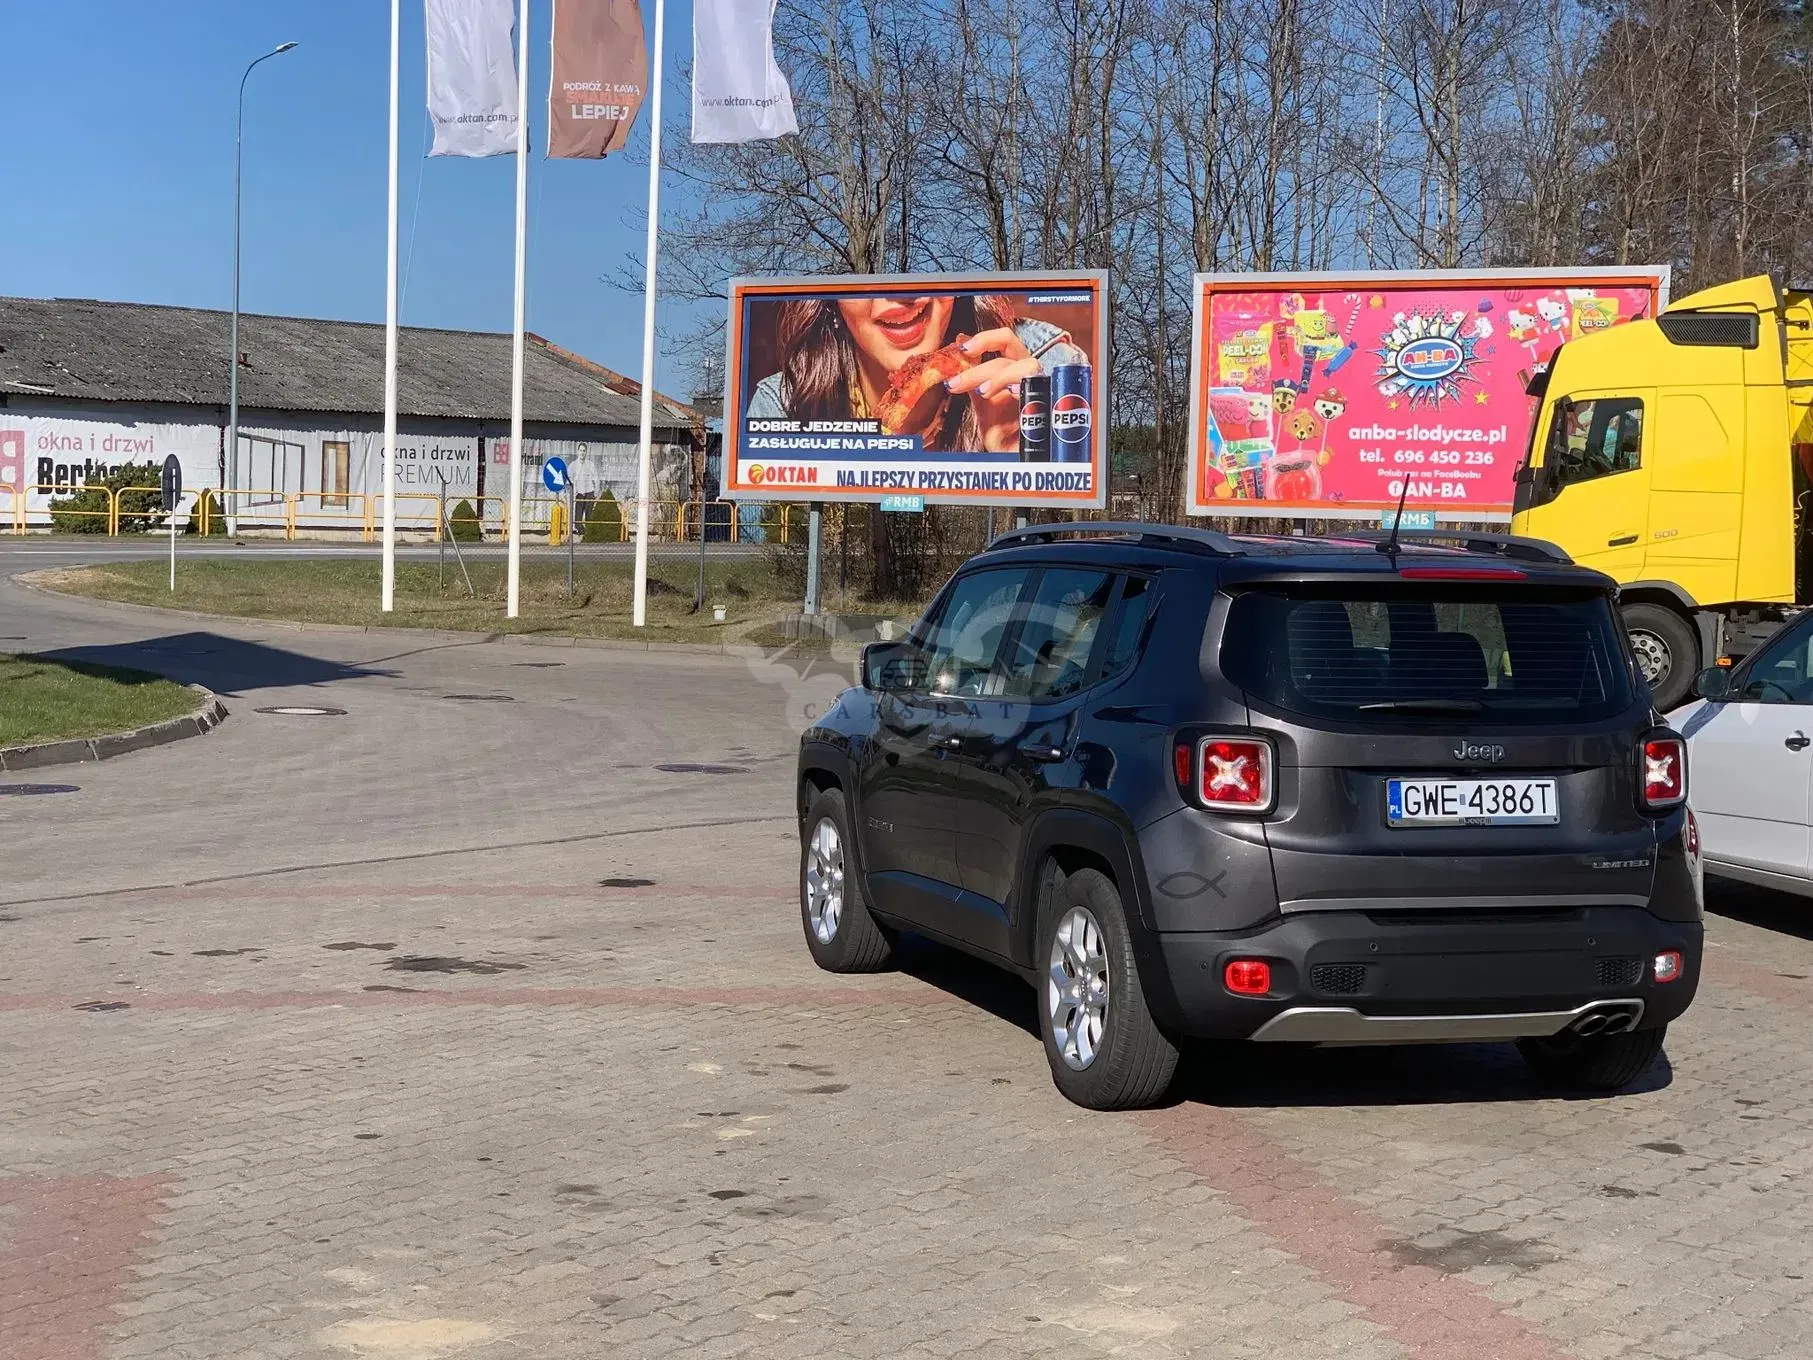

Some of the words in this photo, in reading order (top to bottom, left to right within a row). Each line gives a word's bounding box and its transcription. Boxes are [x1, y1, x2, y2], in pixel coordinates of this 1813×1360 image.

[563, 80, 601, 91] PODRÓŻ
[605, 84, 611, 92] Z
[571, 104, 629, 120] LEPIEJ
[1028, 295, 1091, 303] #THIRSTYFORMORE
[1402, 348, 1457, 365] AN-BA
[749, 421, 800, 432] DOBRE
[802, 421, 878, 433] JEDZENIE
[1054, 413, 1089, 425] PEPSI
[38, 431, 82, 450] okna
[90, 433, 95, 450] i
[102, 434, 154, 453] drzwi
[1349, 424, 1507, 445] anba-slodycze.pl
[749, 437, 842, 449] ZASŁUGUJE
[843, 438, 866, 449] NA
[867, 438, 914, 450] PEPSI
[422, 444, 426, 459] i
[431, 445, 470, 460] drzwi
[1359, 449, 1385, 463] tel.
[1394, 450, 1425, 464] 696
[1429, 451, 1460, 465] 450
[1465, 452, 1494, 465] 236
[766, 466, 818, 483] OKTAN
[836, 470, 915, 488] NAJLEPSZY
[918, 471, 1009, 490] PRZYSTANEK
[1012, 472, 1031, 491] PO
[1035, 472, 1091, 491] DRODZE
[1377, 469, 1403, 478] Polub
[1405, 482, 1467, 499] AN-BA
[1453, 740, 1505, 763] Jeep
[1404, 784, 1458, 816] GWE
[1468, 784, 1551, 815] 4386T
[1390, 805, 1401, 814] PL
